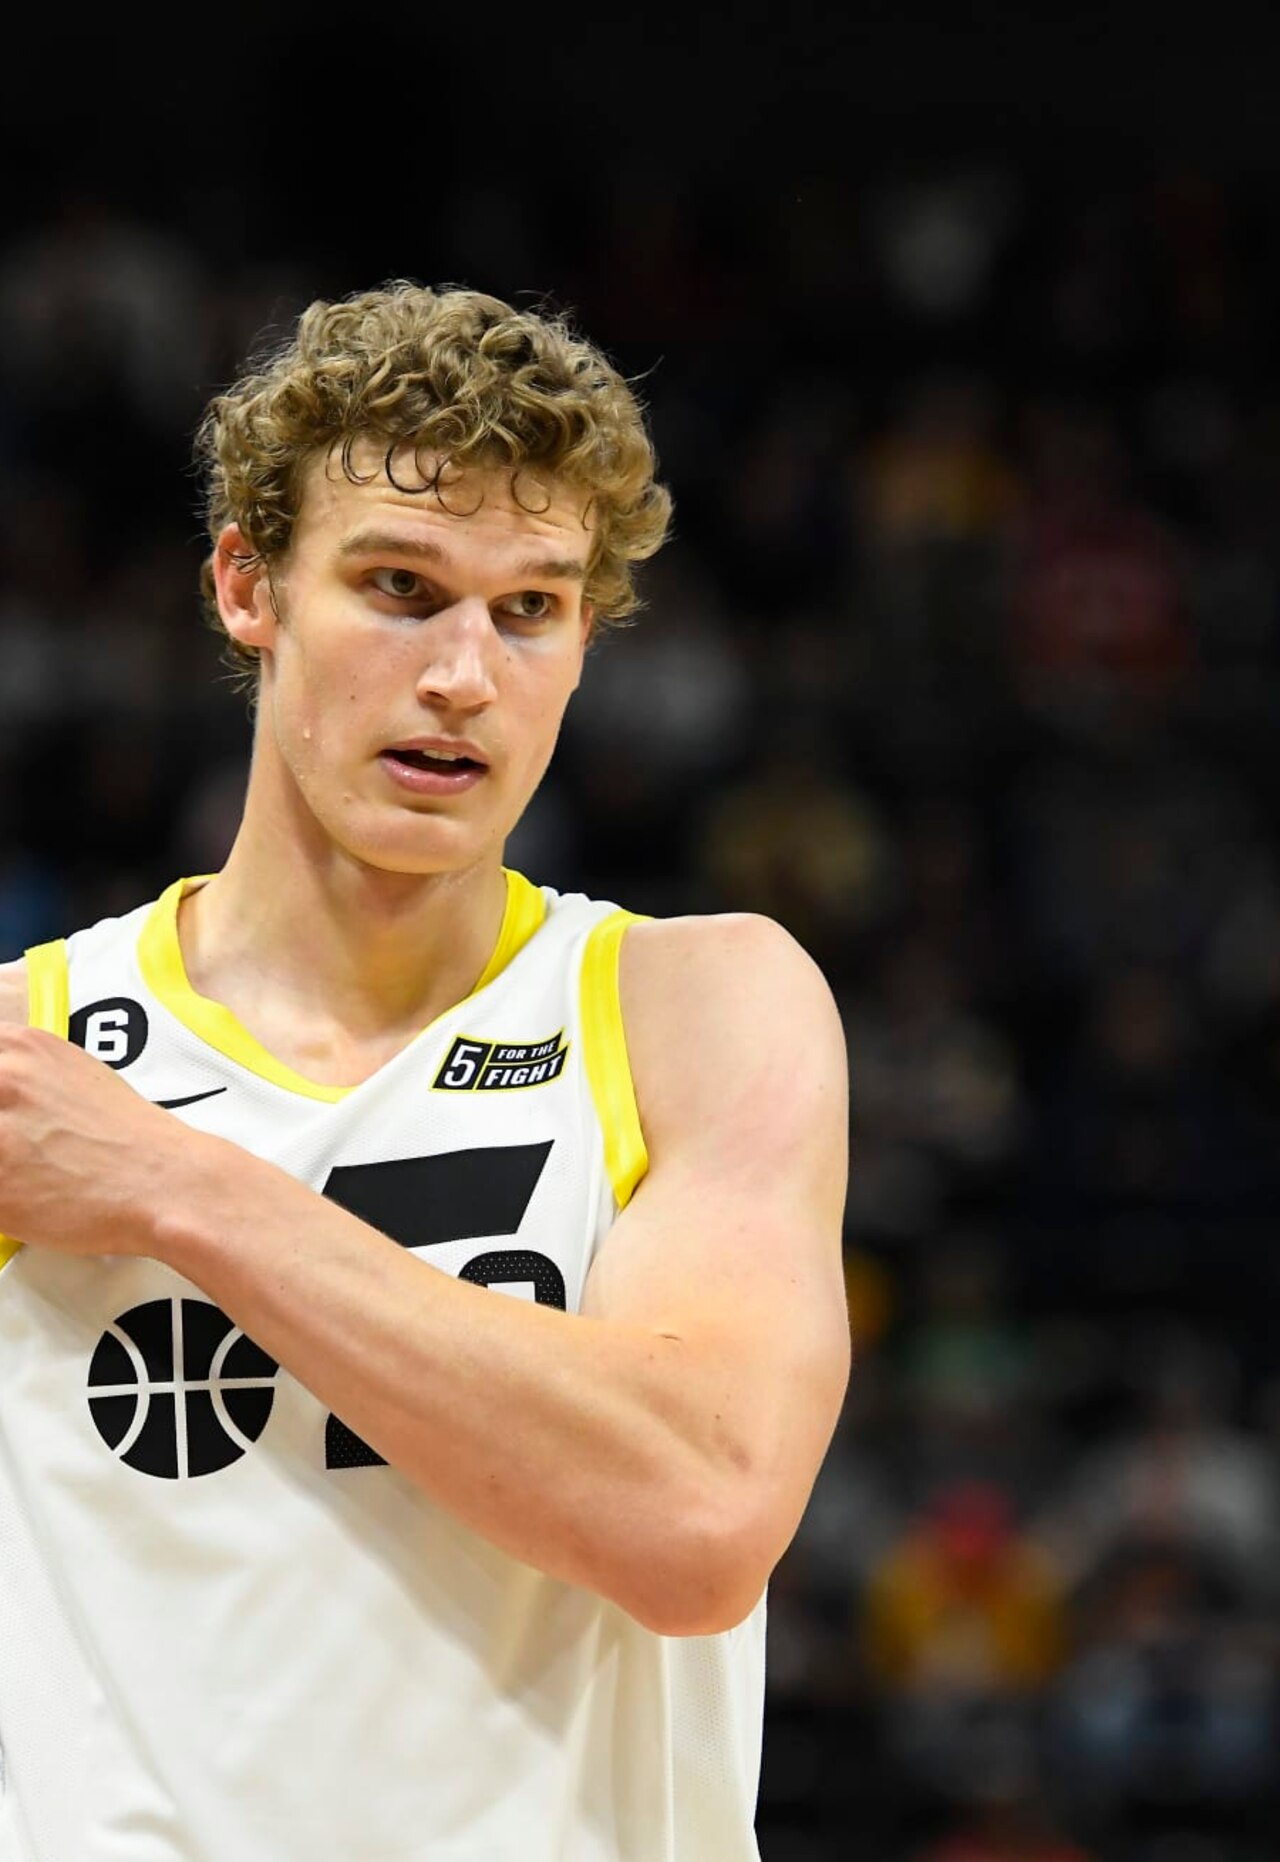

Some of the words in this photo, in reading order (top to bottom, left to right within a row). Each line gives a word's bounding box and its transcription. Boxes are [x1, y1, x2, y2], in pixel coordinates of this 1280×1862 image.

[85, 1008, 128, 1062] 6
[497, 1048, 529, 1060] FOR
[531, 1040, 557, 1058] THE
[444, 1044, 482, 1086] 5
[484, 1055, 562, 1086] FIGHT
